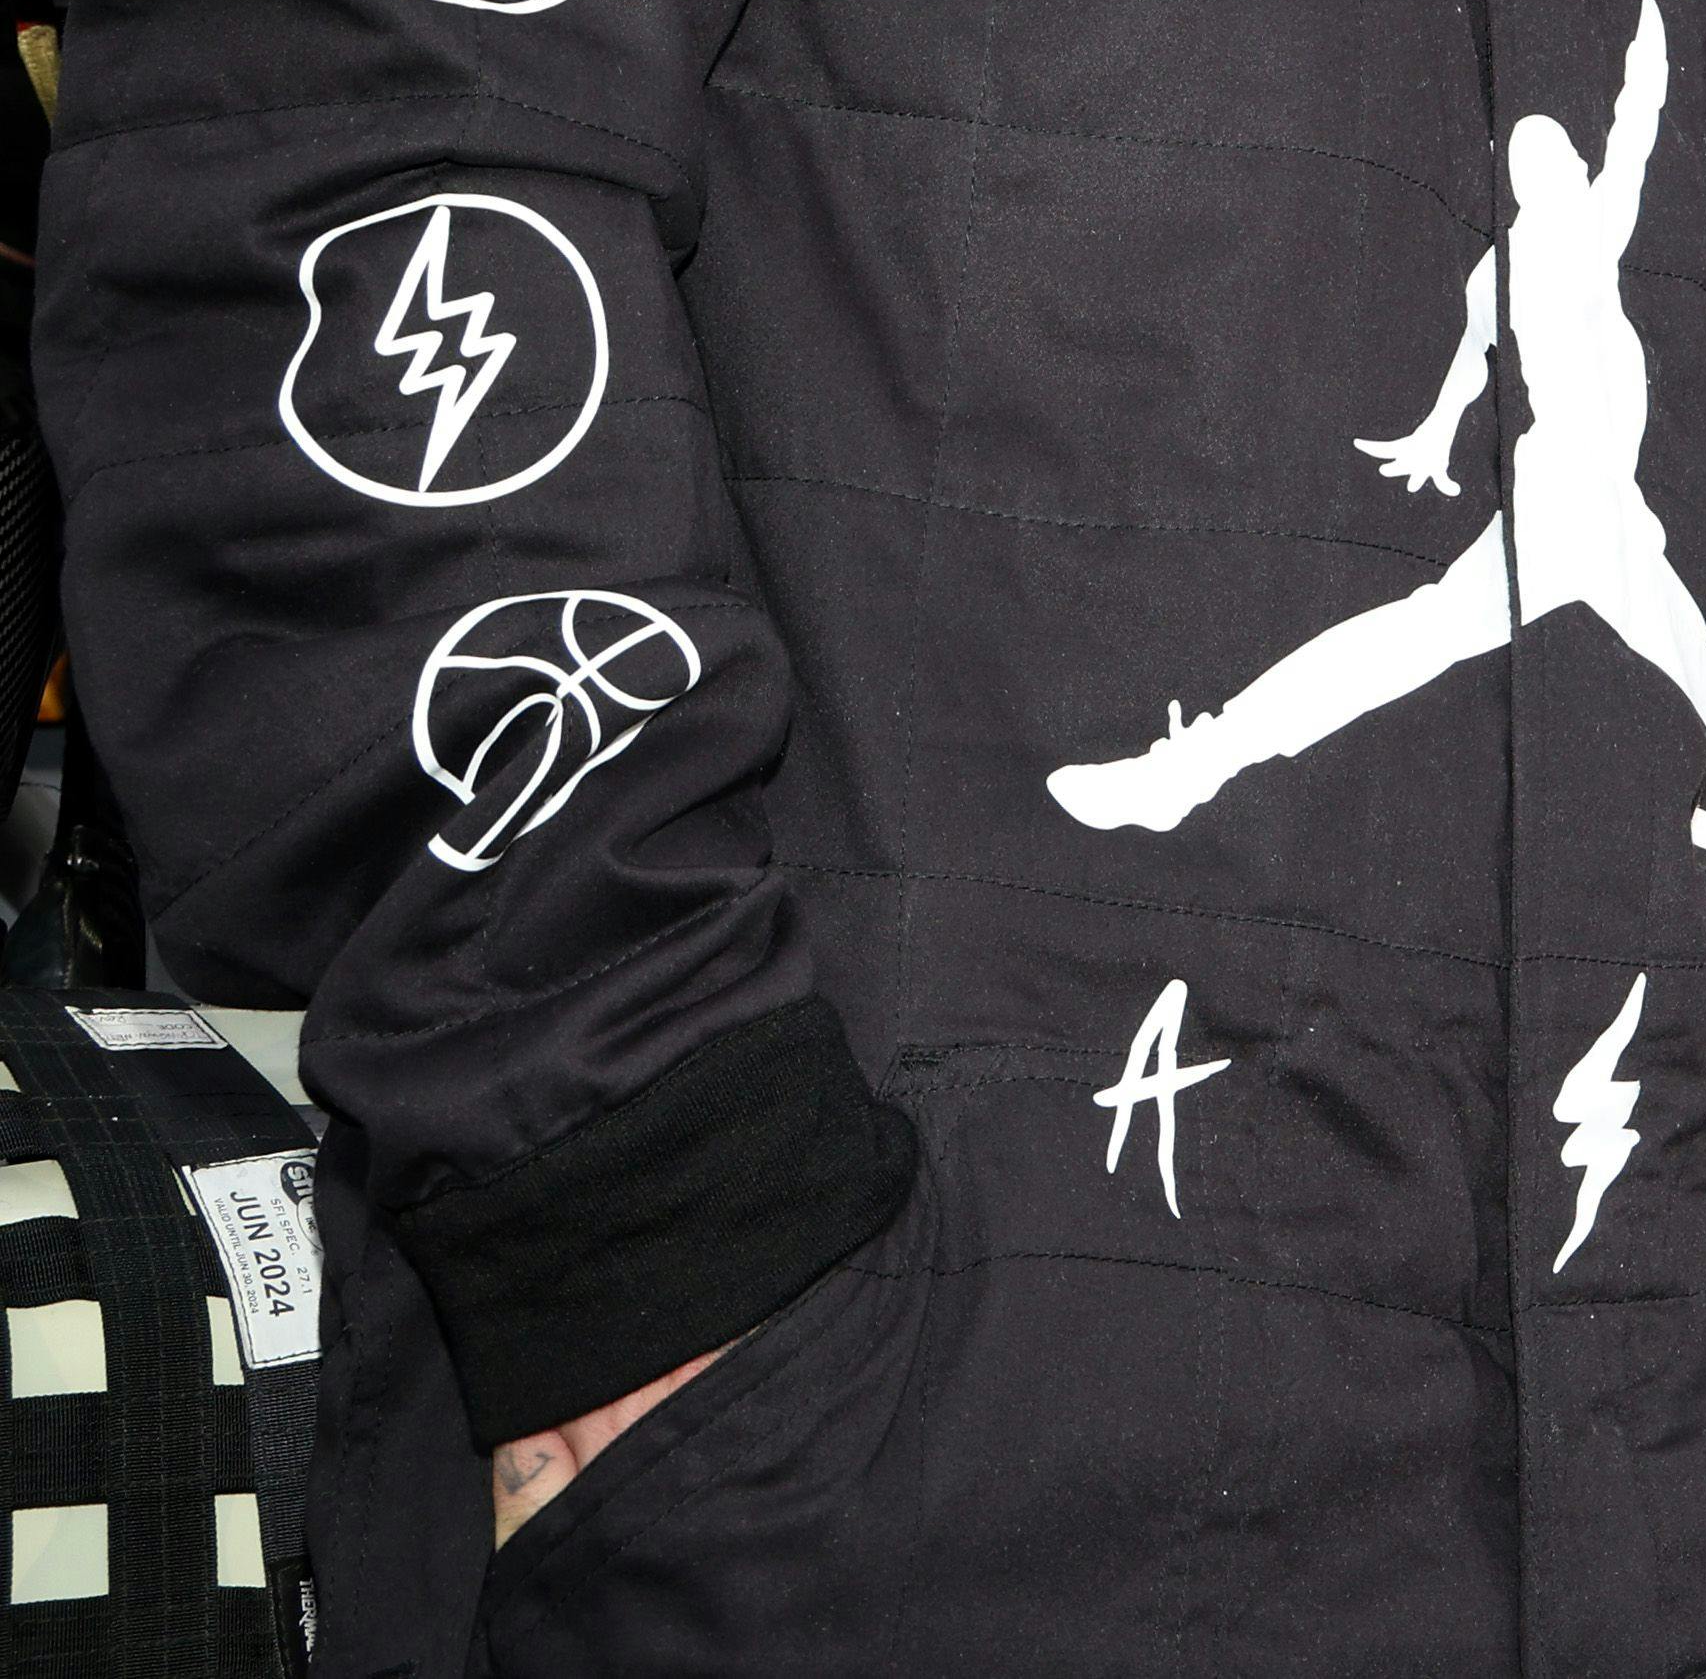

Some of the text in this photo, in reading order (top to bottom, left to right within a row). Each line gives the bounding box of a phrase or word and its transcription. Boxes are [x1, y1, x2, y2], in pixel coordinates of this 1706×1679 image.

[214, 1197, 231, 1226] VALID
[226, 1223, 241, 1251] UNTIL
[235, 1250, 249, 1271] JUN
[246, 1289, 260, 1314] 2024
[230, 1191, 295, 1318] JUN 2024
[270, 1198, 286, 1217] SFI
[296, 1266, 313, 1294] 27.1
